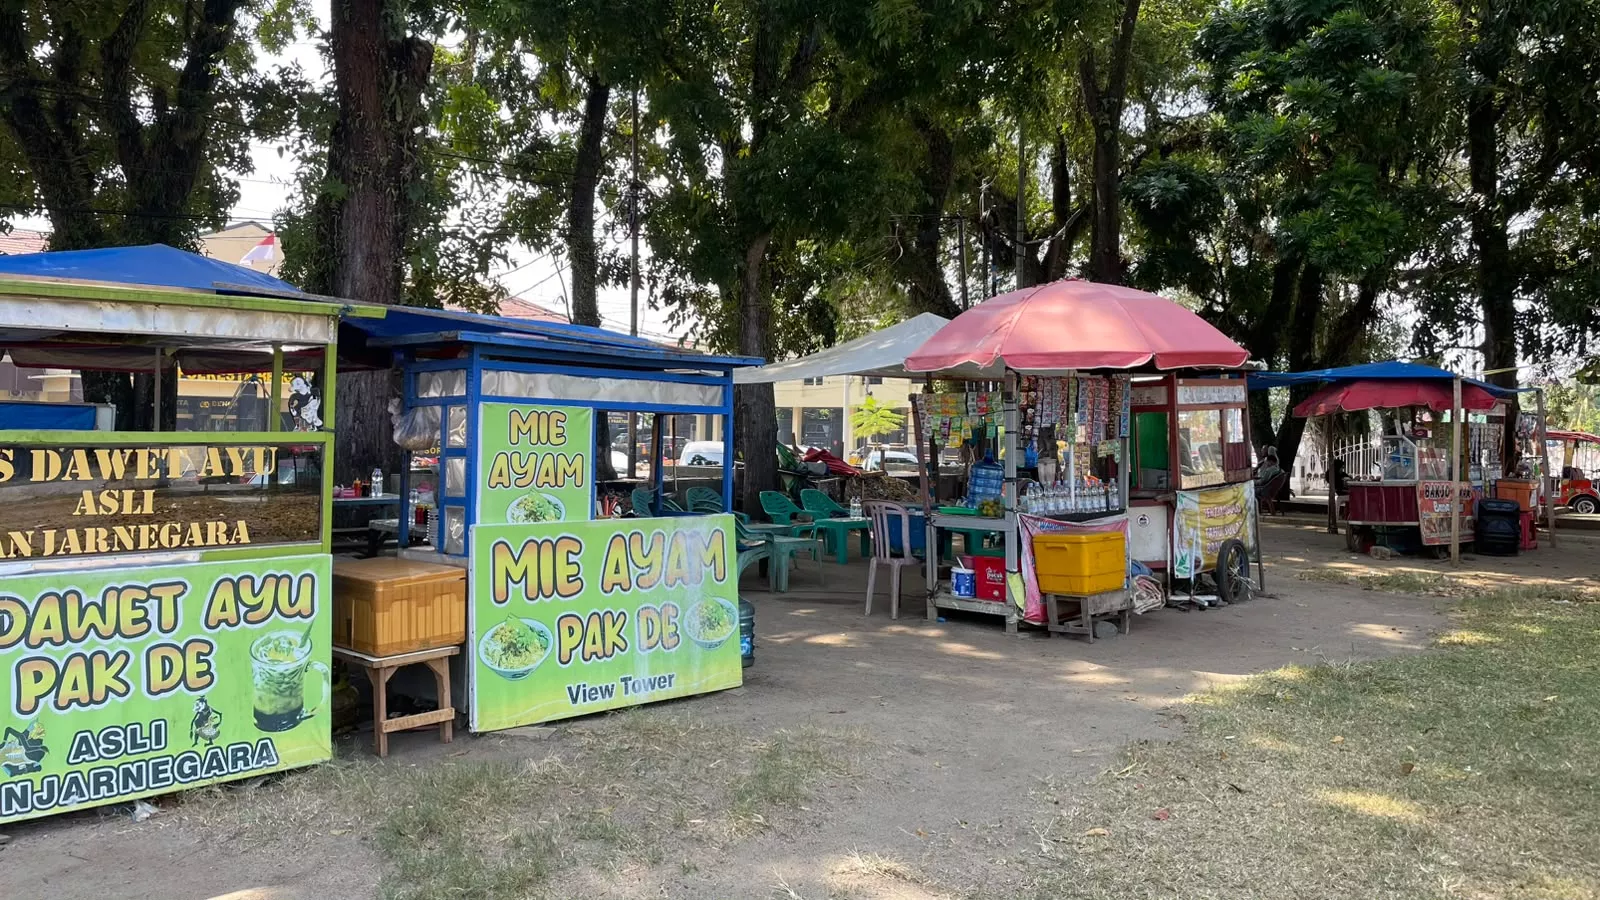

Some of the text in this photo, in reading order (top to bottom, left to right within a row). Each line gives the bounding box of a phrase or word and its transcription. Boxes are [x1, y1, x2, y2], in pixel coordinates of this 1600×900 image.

[509, 409, 567, 446] MIE
[30, 447, 187, 481] DAWET
[200, 446, 278, 478] AYU
[488, 452, 584, 489] AYAM
[73, 489, 155, 516] ASLI
[491, 529, 726, 604] MIE AYAM
[0, 572, 316, 650] DAWET AYU
[556, 602, 680, 665] PAK DE
[16, 639, 215, 714] PAK DE
[567, 673, 675, 705] View Tower
[68, 719, 167, 765] ASLI
